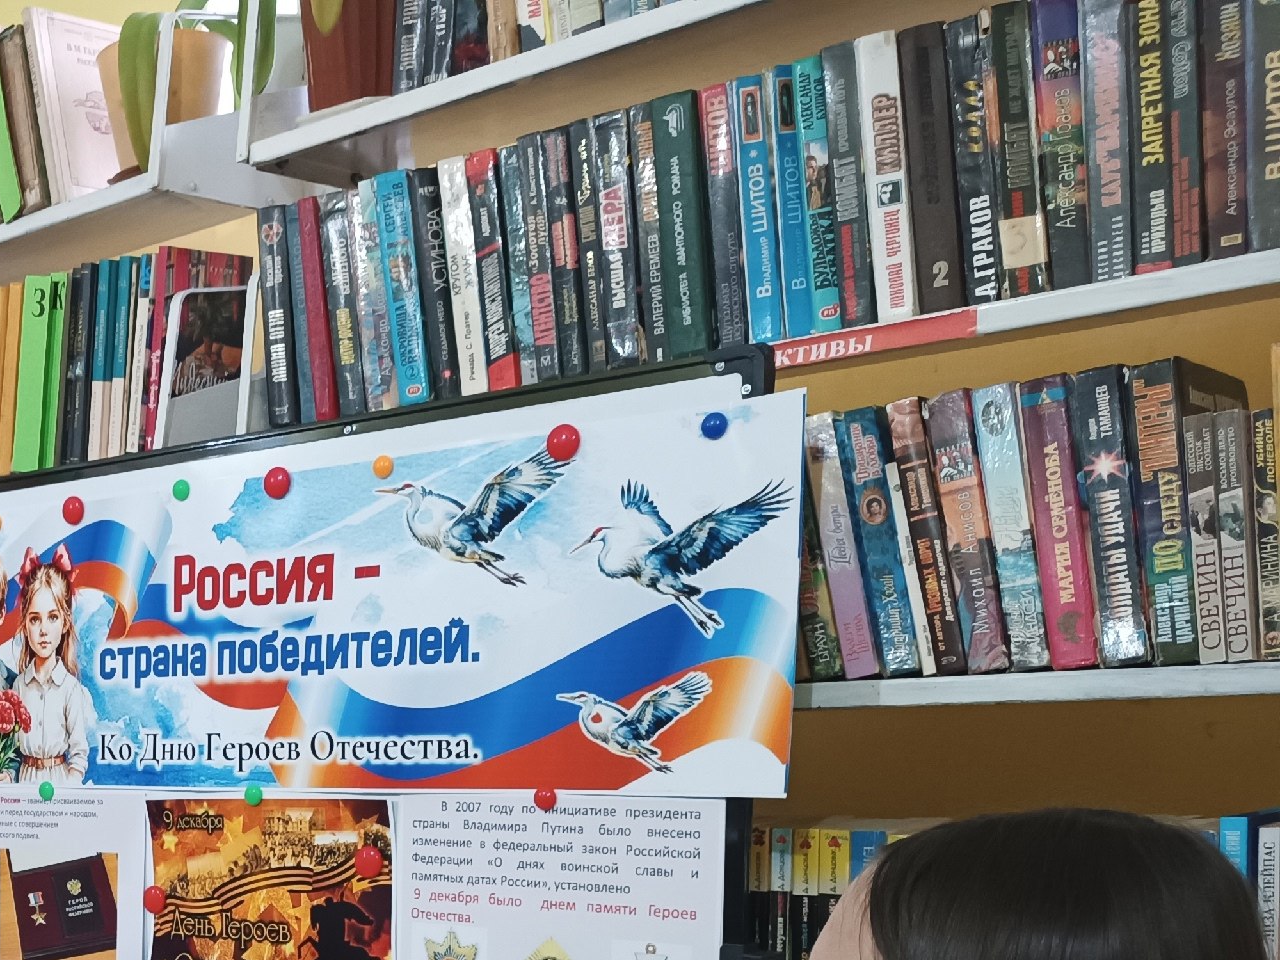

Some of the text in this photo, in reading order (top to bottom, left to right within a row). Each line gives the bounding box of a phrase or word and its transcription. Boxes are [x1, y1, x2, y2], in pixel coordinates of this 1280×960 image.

[799, 72, 815, 131] АЛЕКСАНДР
[1140, 51, 1164, 167] ЗАПРЕТНАЯ
[872, 92, 902, 176] КИЛЛЕР
[382, 192, 396, 234] СЕРГЕЙ
[783, 154, 802, 224] ШИТОВ
[833, 155, 858, 222] КОМБАТ
[427, 207, 447, 293] УСТИНОВА
[601, 186, 627, 309] МЕРА ВЫСШАЯ
[647, 233, 662, 285] ЕРЕМЕЕВ
[748, 163, 773, 299] ШИТОВ Владимир
[449, 253, 462, 297] КРУГОМ
[932, 261, 949, 288] 2
[529, 273, 556, 346] АГЕНТСТВО
[652, 285, 665, 336] ВАЛЕРИЙ
[1096, 384, 1113, 439] ТАМАНЦЕВ
[1256, 420, 1265, 468] УБИЙЦА
[1265, 418, 1275, 483] ПОНЕВОЛЕ
[1095, 488, 1126, 549] УДАЧИ
[1158, 470, 1183, 535] СЛЕДУ
[174, 552, 335, 613] Россия
[1054, 541, 1076, 605] МАРИЯ
[1196, 549, 1221, 651] СВЕЧИН
[1260, 534, 1280, 612] МАРИНИНА
[1223, 552, 1249, 655] СВЕЧИН
[99, 617, 481, 688] страна победителей.
[99, 730, 479, 772] Ко Дню Героев Отечества.
[163, 810, 224, 833] 9 декабря
[412, 818, 701, 840] страны Владимира Путина было внесено
[441, 802, 702, 821] В 2007 году по инициативе президента
[411, 852, 699, 878] Федерации «О днях воинской славы и
[412, 837, 701, 860] изменение в федеральный закон Российской
[411, 873, 631, 895] памятных датах России», установлено
[414, 888, 697, 921] 9 декабря было днем памяти Героев
[171, 908, 291, 948] День Героев
[411, 907, 475, 924] Отечества.
